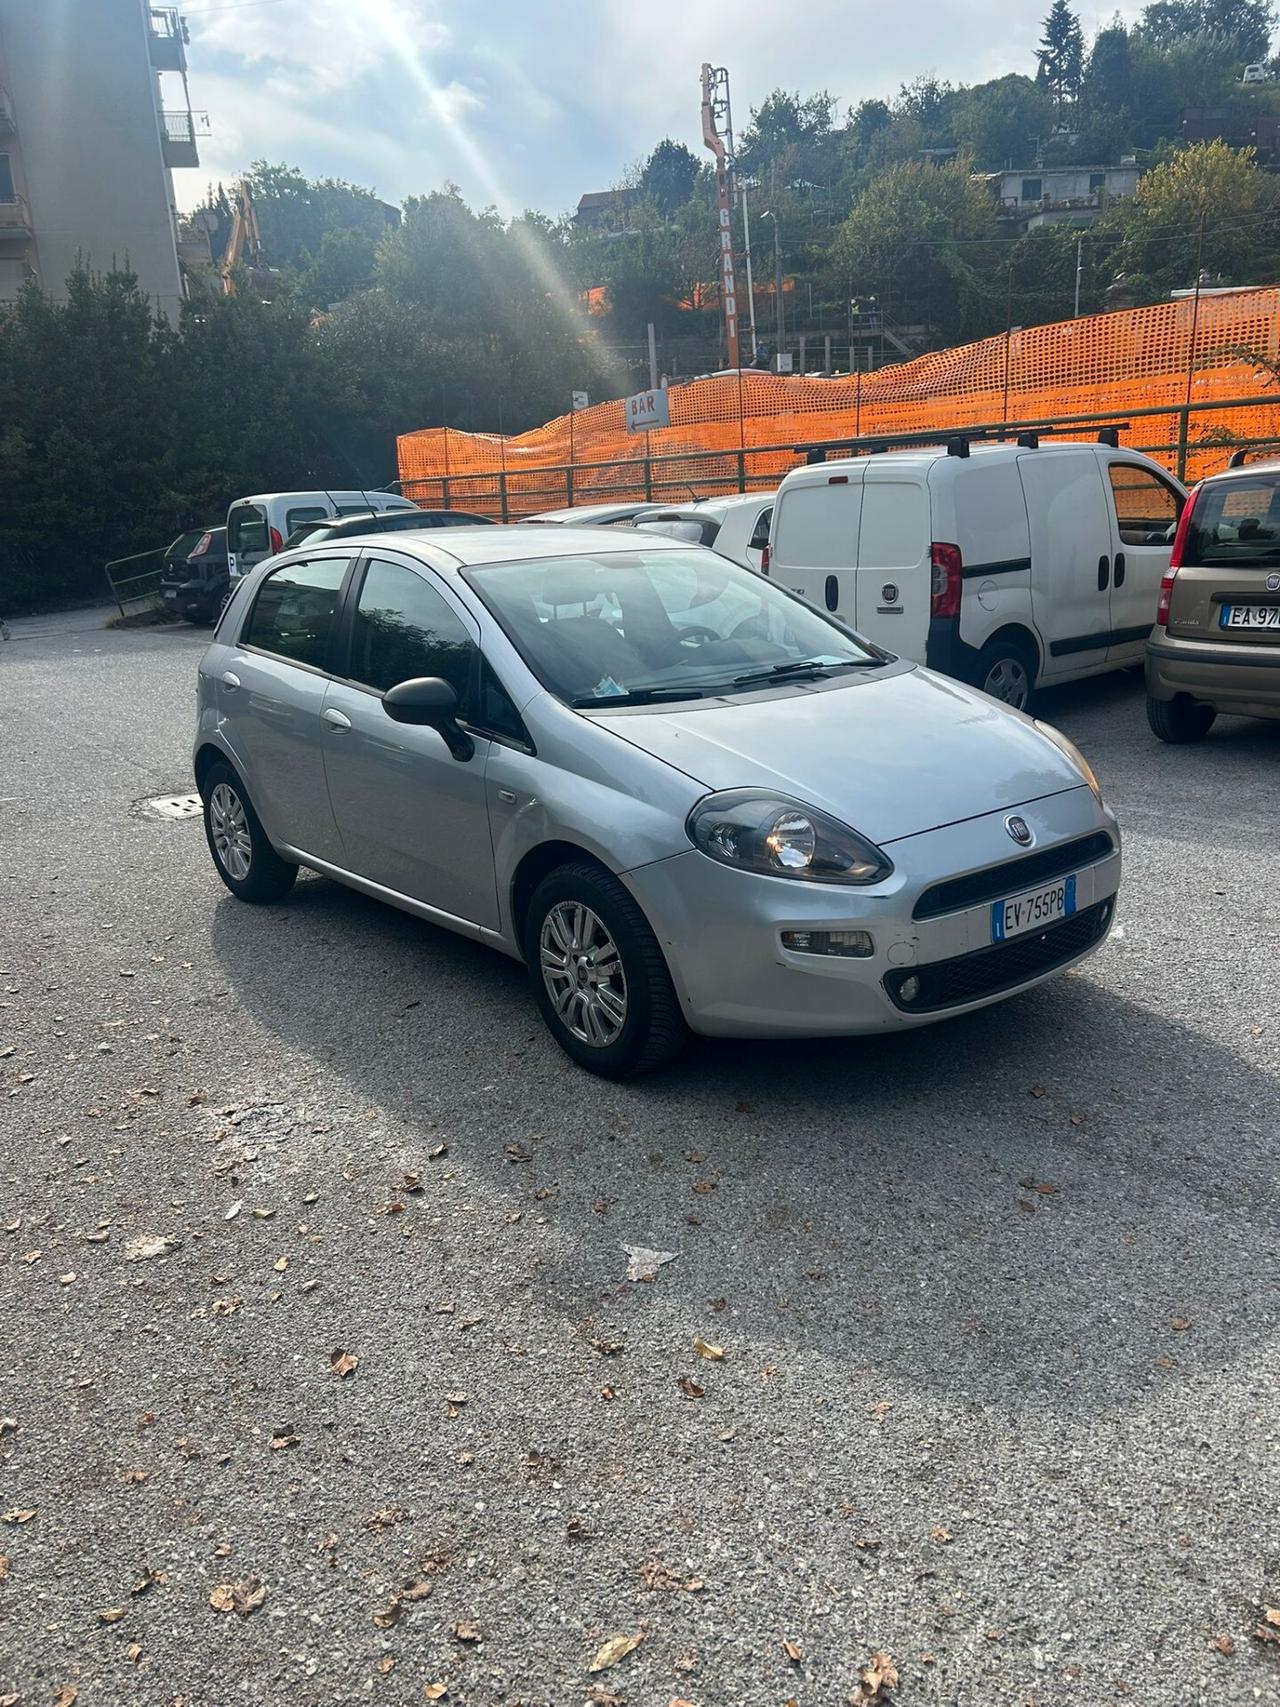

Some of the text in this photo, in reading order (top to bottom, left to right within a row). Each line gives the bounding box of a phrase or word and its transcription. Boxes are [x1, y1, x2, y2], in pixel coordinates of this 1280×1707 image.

[719, 208, 736, 338] GRANDI
[631, 396, 655, 416] BAR
[1232, 607, 1280, 626] EA 97
